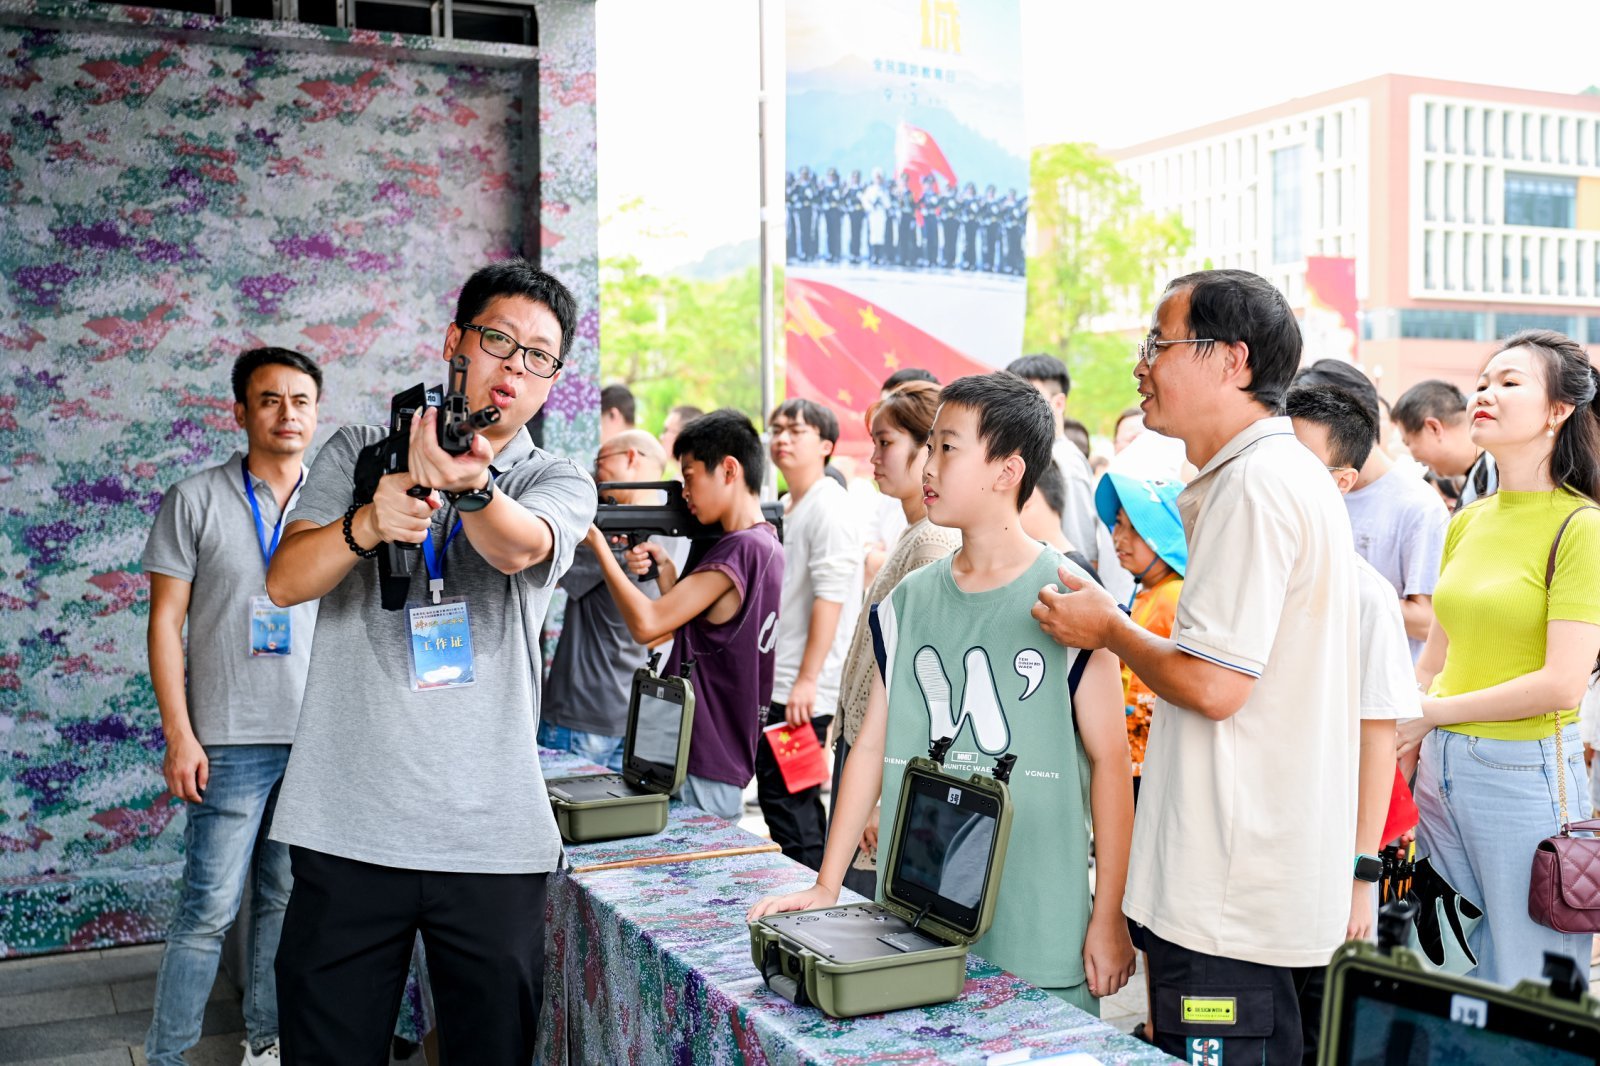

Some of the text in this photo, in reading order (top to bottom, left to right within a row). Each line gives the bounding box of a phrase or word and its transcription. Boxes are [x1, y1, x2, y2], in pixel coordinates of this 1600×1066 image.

[424, 635, 464, 651] 工作证
[884, 757, 909, 766] DIENM
[1025, 769, 1060, 779] VGNIATE
